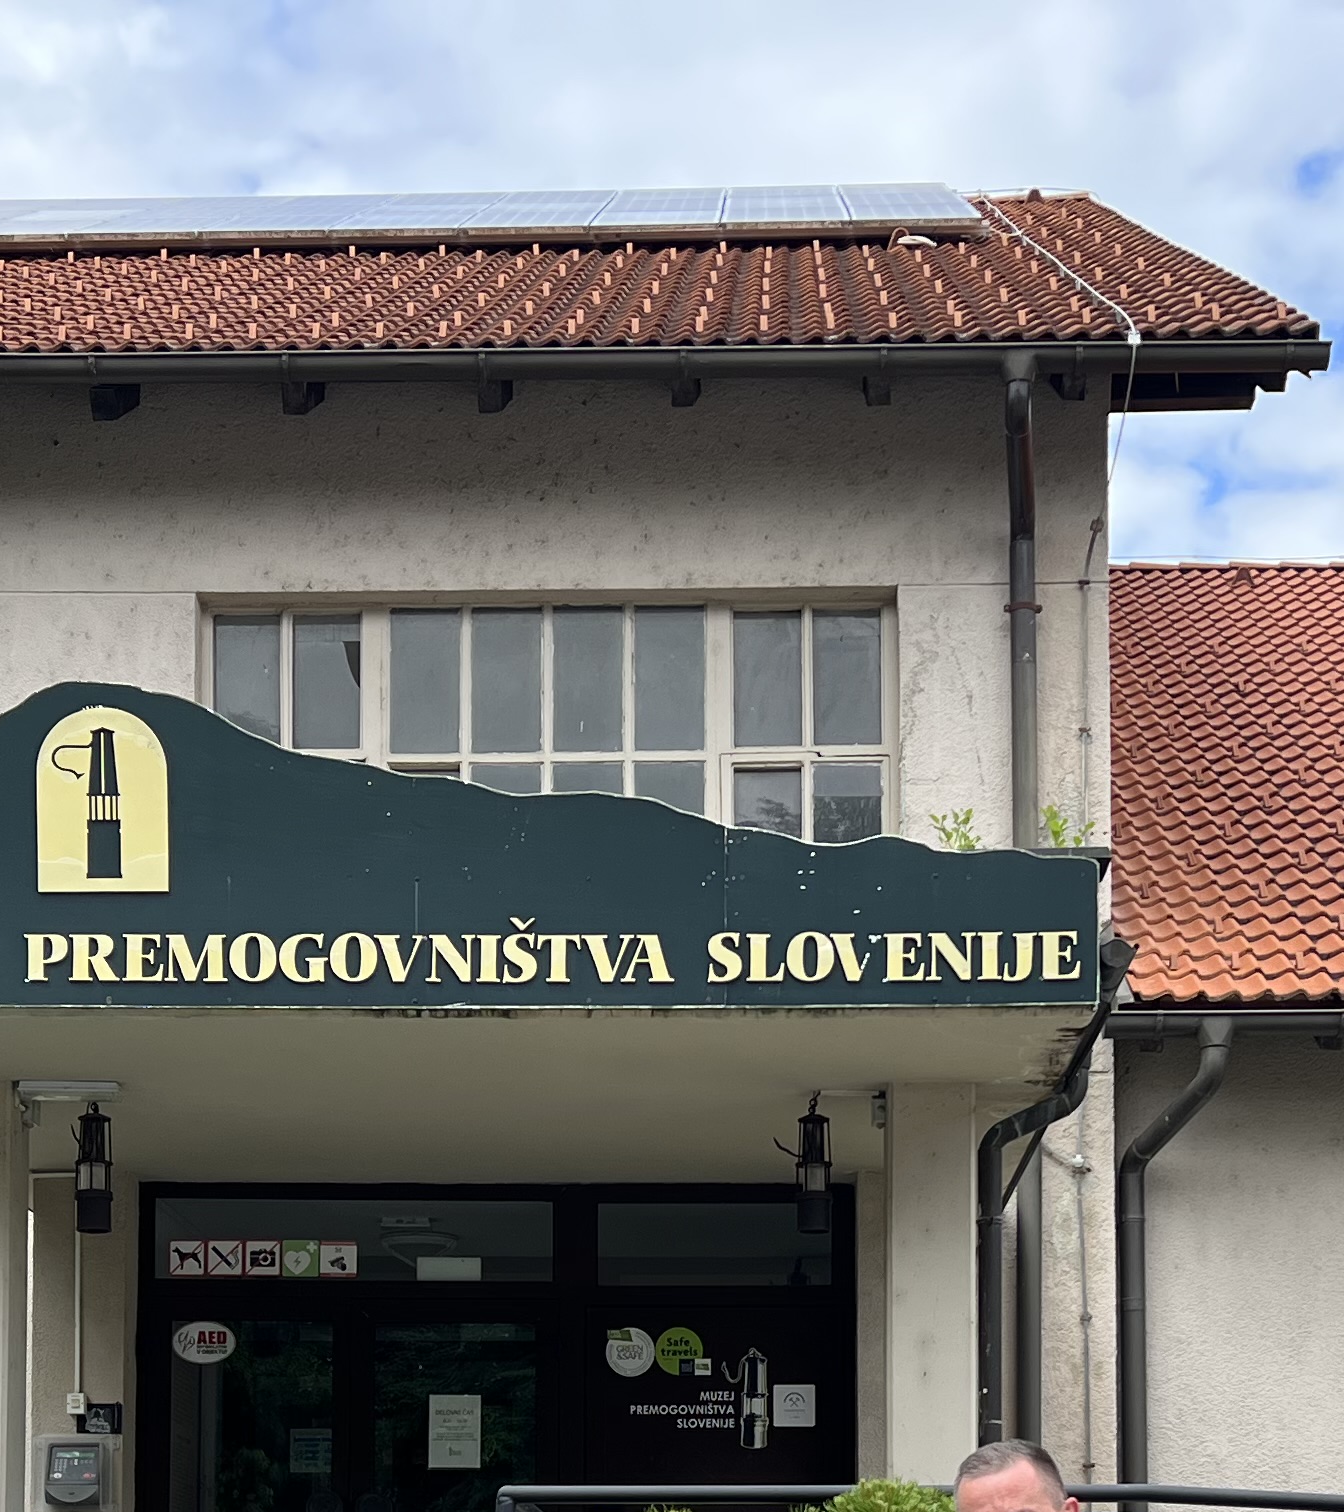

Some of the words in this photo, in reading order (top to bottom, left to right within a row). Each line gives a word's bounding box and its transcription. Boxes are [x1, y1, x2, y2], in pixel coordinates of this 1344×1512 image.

[23, 917, 674, 984] PREMOGOVNIŠTVA
[707, 930, 1082, 983] SLOVENIJE
[197, 1331, 227, 1345] AED
[666, 1336, 690, 1347] Safe
[661, 1347, 698, 1357] travels
[699, 1390, 735, 1401] MUZEJ
[629, 1402, 735, 1415] PREMOGOVNIŠTVA
[676, 1418, 735, 1429] SLOVENIJE
